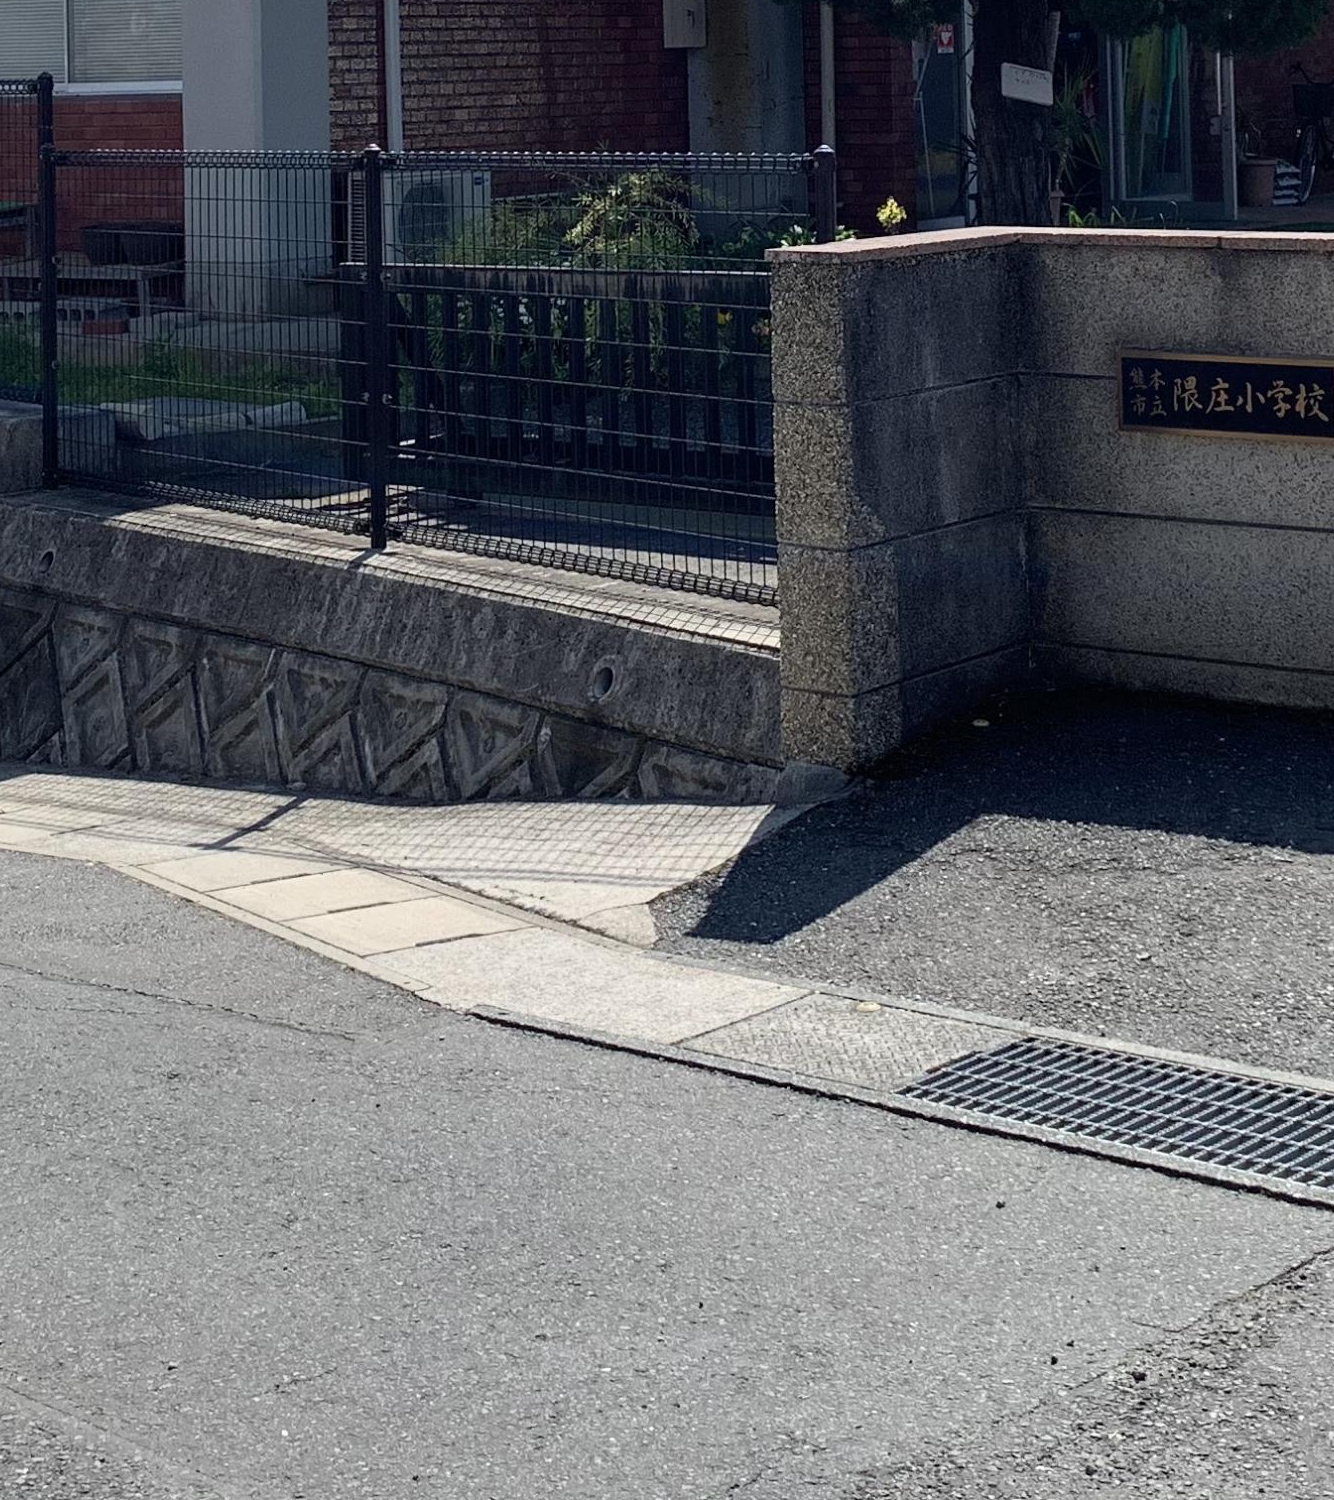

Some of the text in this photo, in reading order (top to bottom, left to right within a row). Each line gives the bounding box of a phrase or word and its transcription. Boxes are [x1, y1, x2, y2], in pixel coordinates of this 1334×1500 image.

[1173, 376, 1330, 422] 隈庄小学校
